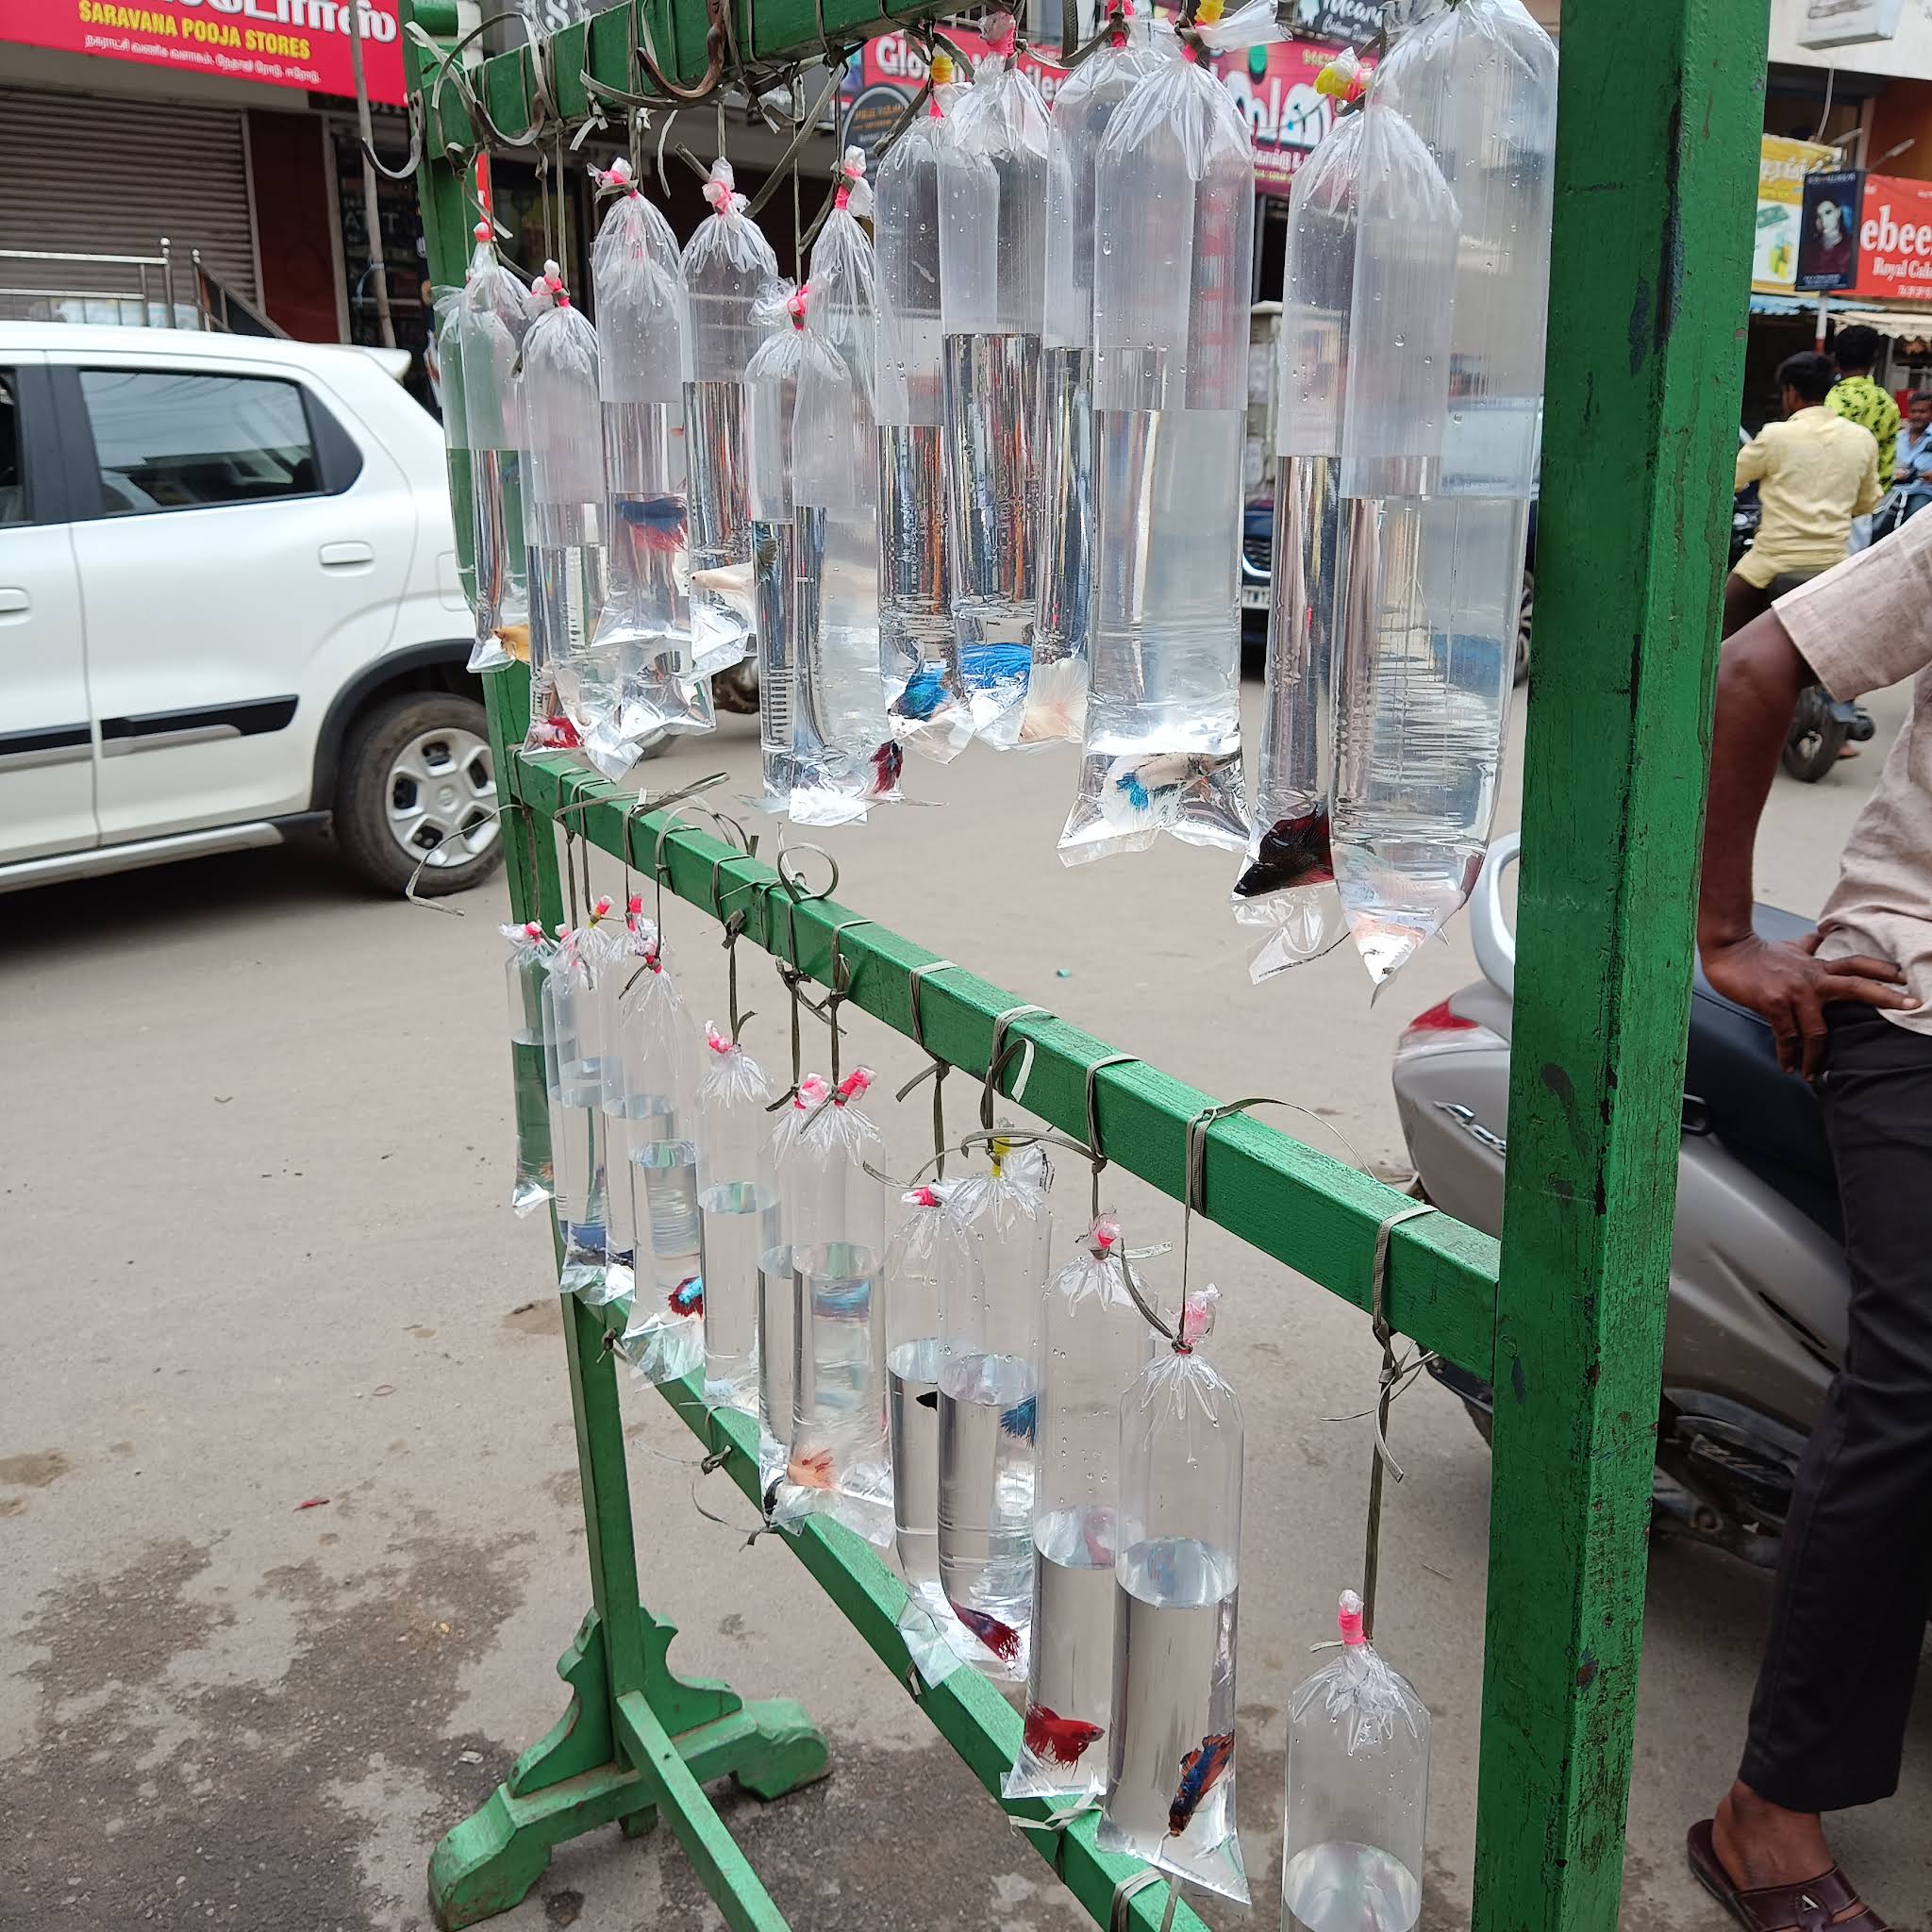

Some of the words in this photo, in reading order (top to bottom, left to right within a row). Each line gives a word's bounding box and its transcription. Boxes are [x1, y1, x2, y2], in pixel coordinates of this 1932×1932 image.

[78, 0, 178, 38] SARAVANA
[181, 17, 242, 48] POOJA
[244, 29, 311, 60] STORES
[1859, 204, 1932, 257] ebee
[1872, 256, 1908, 282] Royal
